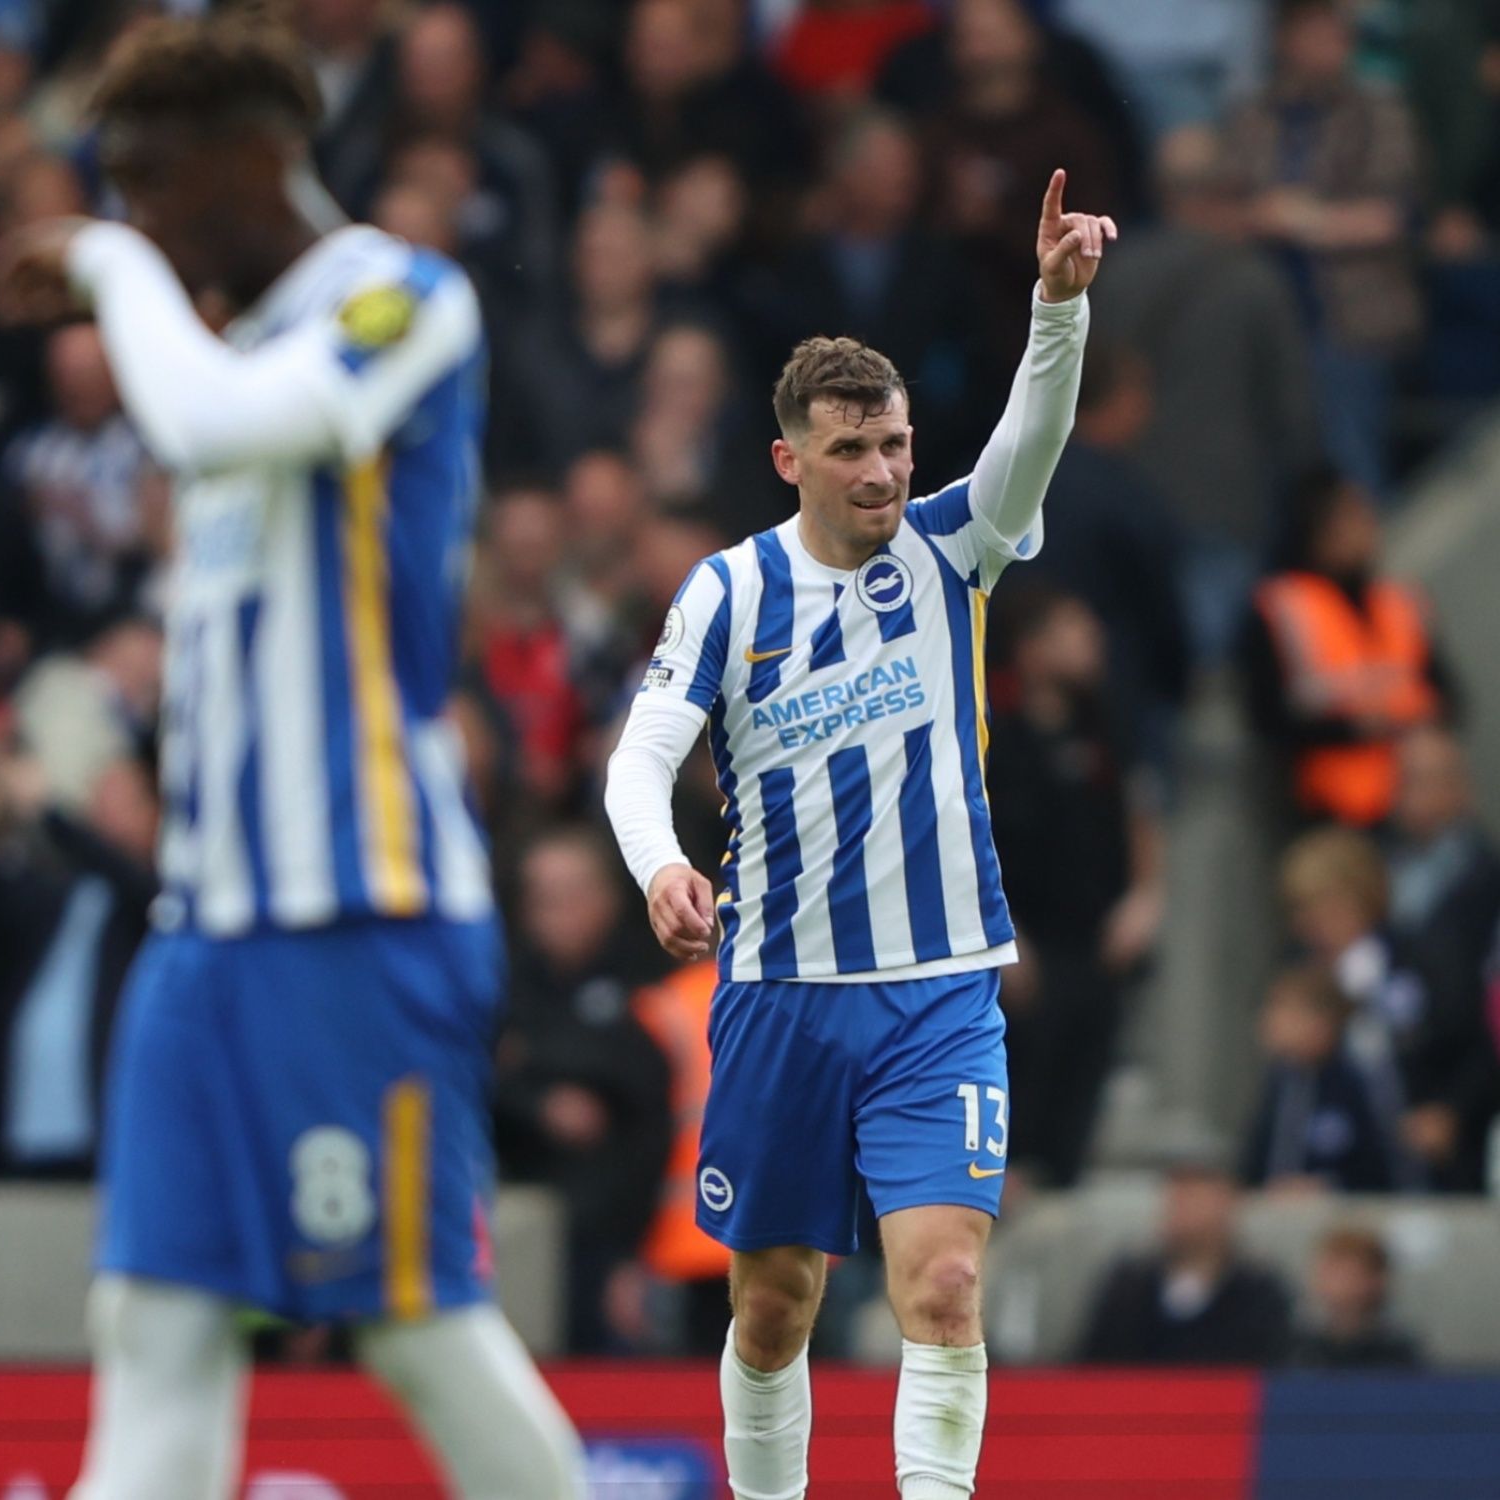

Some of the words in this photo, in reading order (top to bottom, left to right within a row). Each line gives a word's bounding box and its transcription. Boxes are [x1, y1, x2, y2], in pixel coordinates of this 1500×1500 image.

[752, 655, 918, 731] AMERICAN
[778, 682, 926, 750] EXPRESS
[956, 1083, 1008, 1158] 13
[288, 1124, 376, 1244] 8
